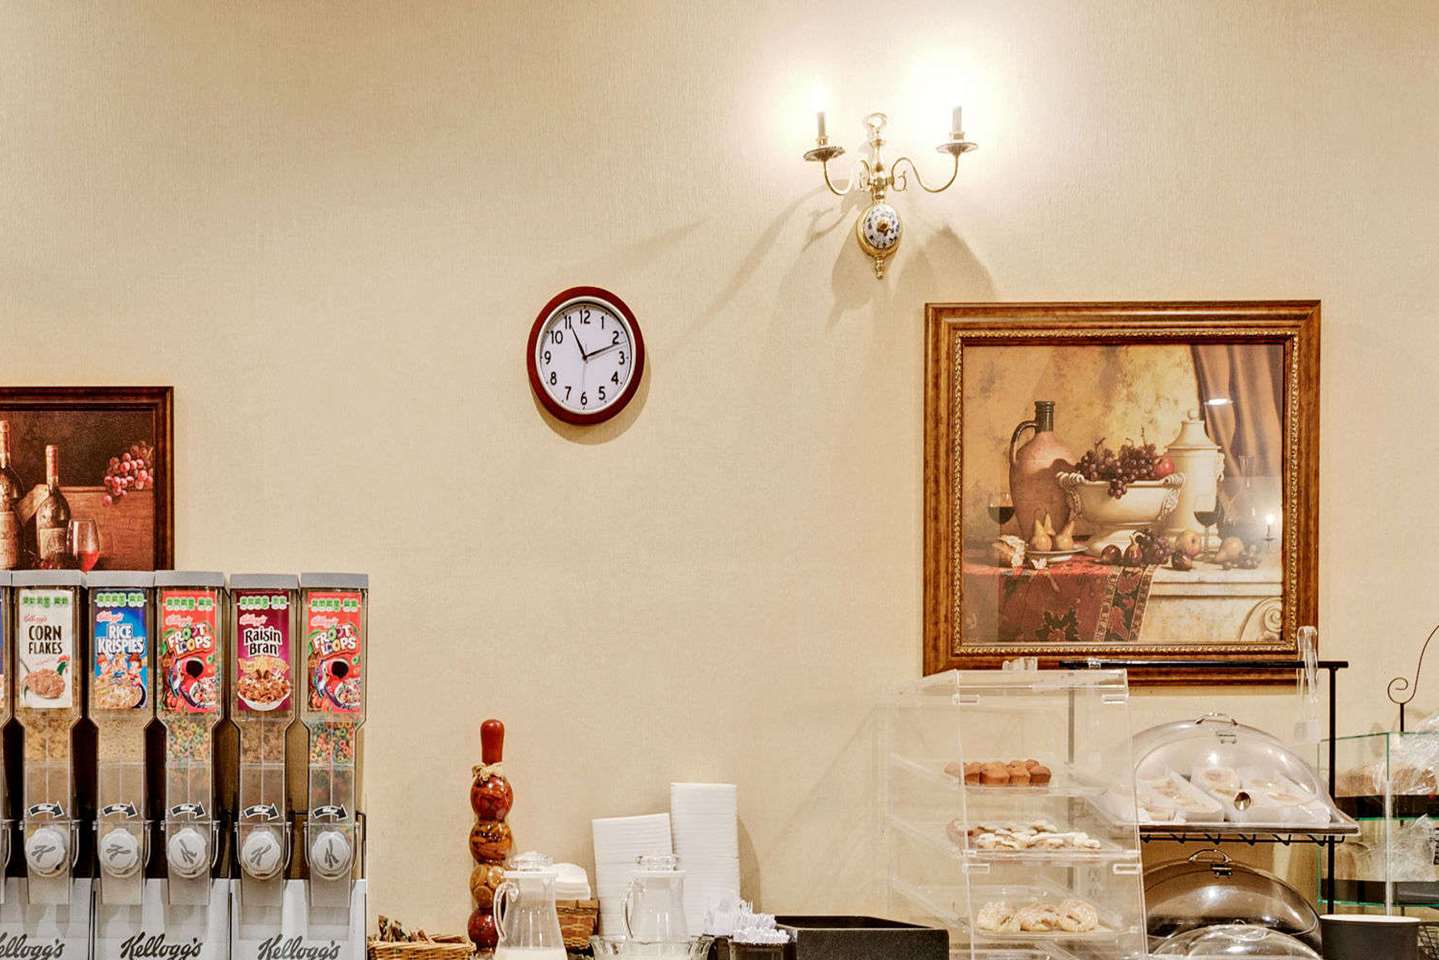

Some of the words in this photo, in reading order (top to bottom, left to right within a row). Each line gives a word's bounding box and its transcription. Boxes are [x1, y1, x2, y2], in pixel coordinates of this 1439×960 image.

[564, 316, 572, 330] 11
[580, 310, 591, 325] 12
[550, 330, 564, 344] 10
[612, 330, 620, 345] 2
[544, 351, 551, 365] 9
[618, 351, 625, 365] 3
[549, 371, 557, 386] 8
[610, 371, 619, 385] 4
[565, 386, 572, 401] 7
[580, 392, 588, 406] 6
[598, 386, 606, 400] 5
[28, 625, 62, 641] CORN
[109, 624, 132, 639] RICE
[245, 627, 281, 643] Raisin
[28, 641, 63, 655] FLAKES
[98, 638, 144, 656] KRISPIES
[250, 642, 277, 655] Bran
